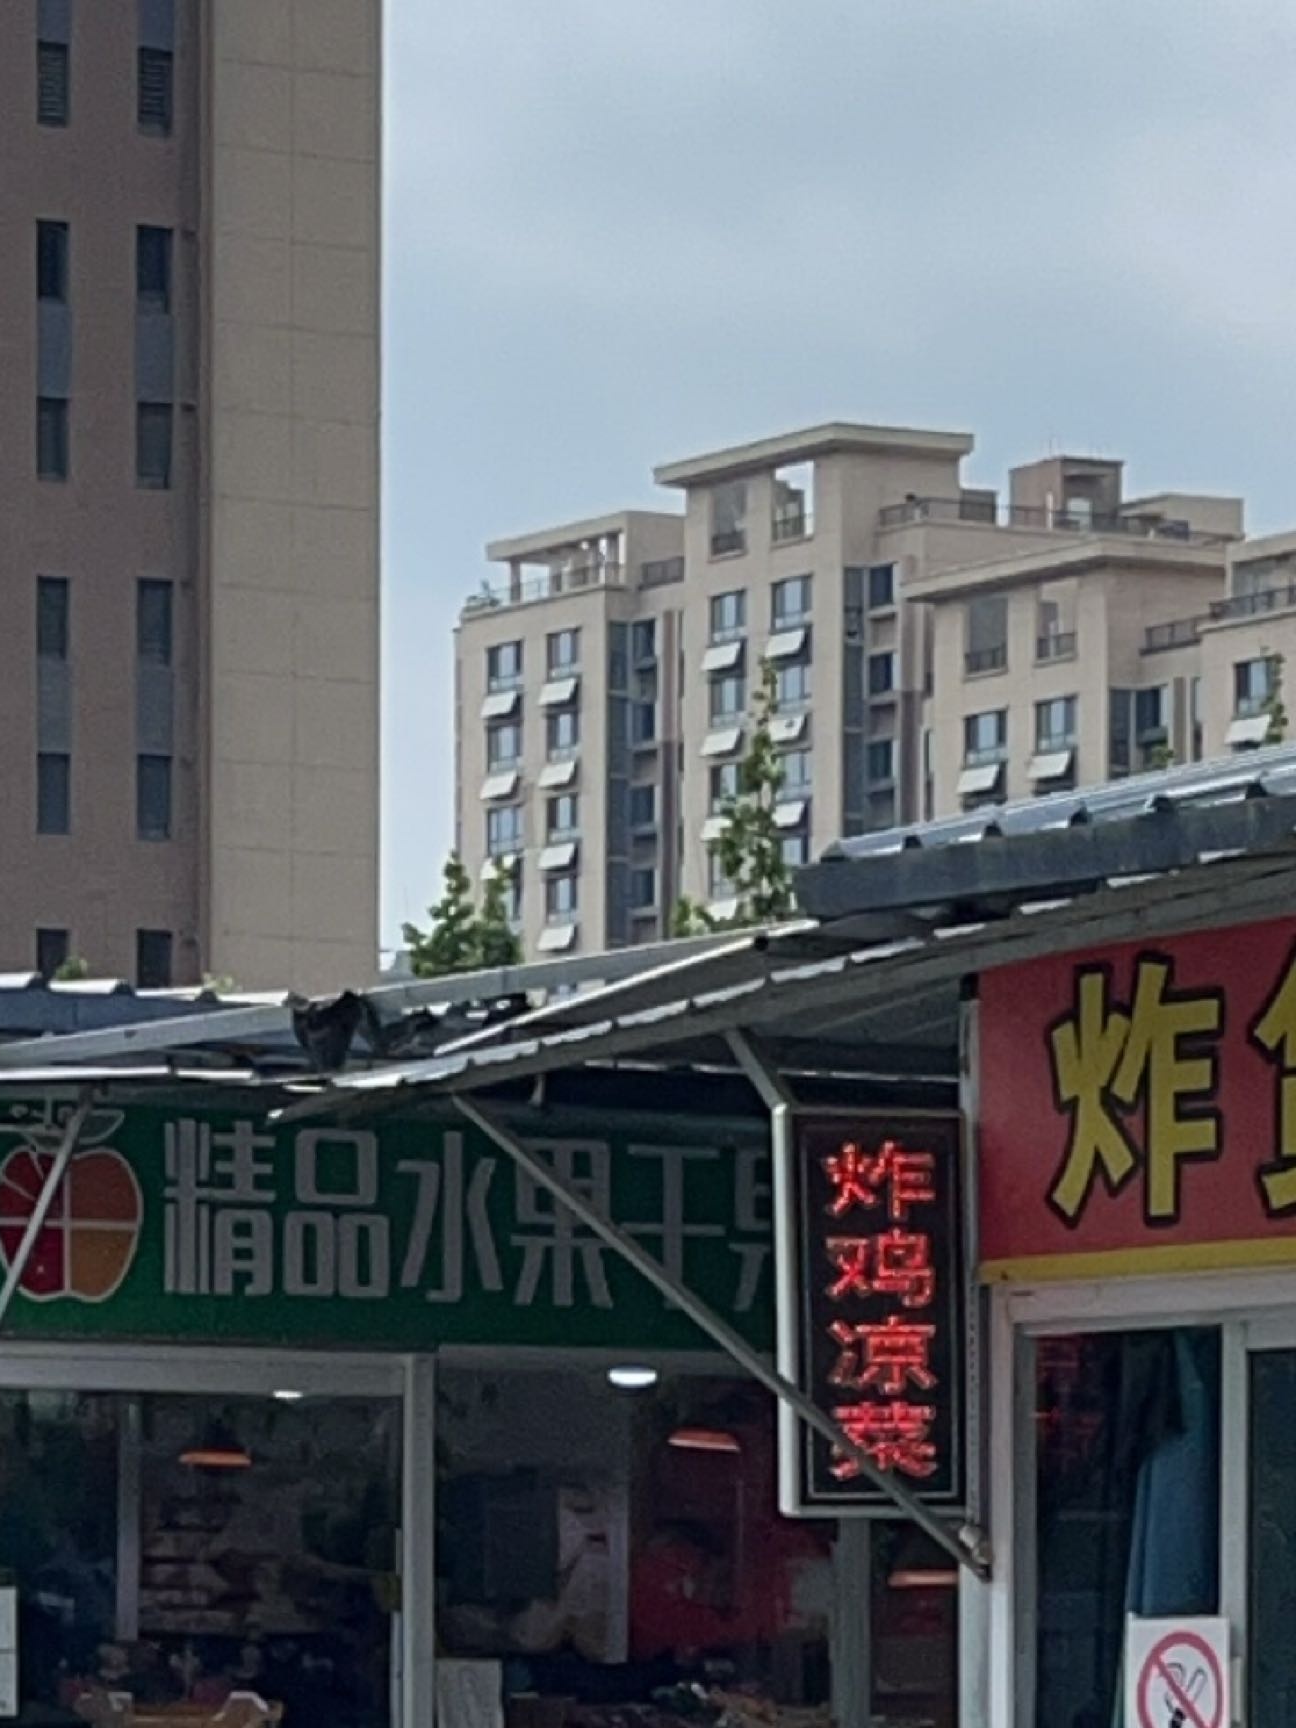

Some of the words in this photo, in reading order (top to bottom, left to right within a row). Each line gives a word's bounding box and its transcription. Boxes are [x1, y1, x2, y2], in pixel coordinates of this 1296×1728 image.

[1047, 932, 1296, 1228] 炸
[823, 1139, 937, 1480] 炸鸡凉菜
